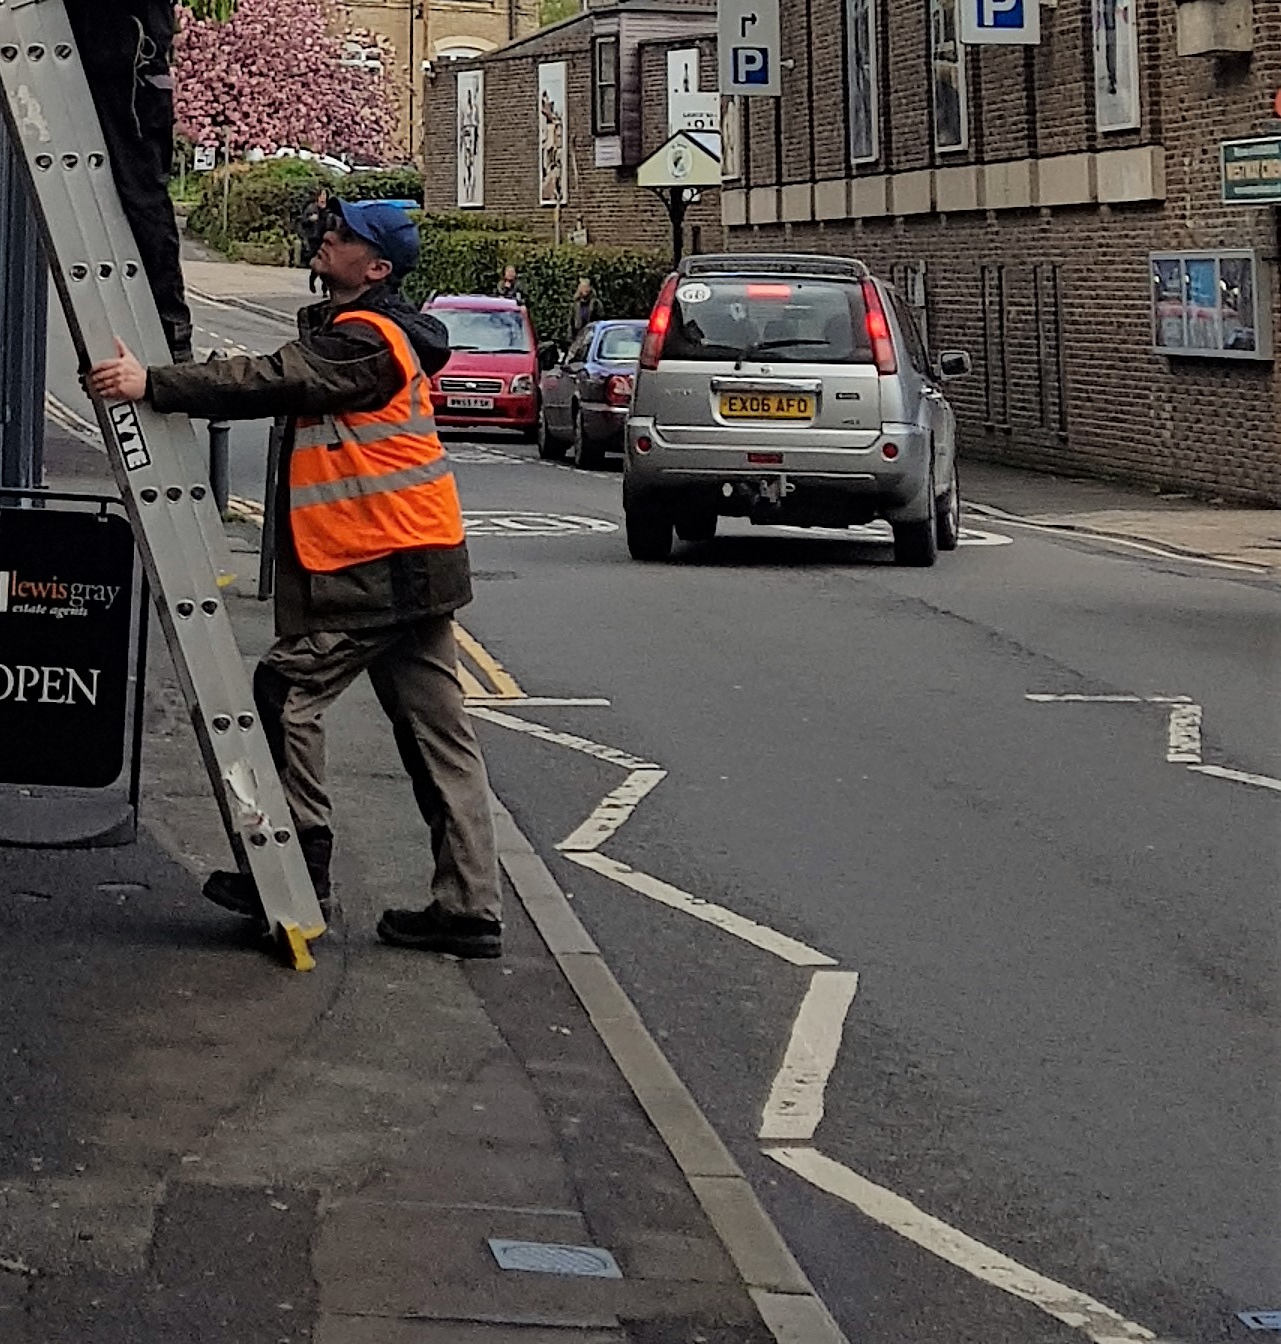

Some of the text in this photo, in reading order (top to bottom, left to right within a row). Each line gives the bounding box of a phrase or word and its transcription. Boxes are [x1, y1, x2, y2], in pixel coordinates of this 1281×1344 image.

[737, 49, 764, 83] P
[728, 396, 772, 413] EX06
[111, 402, 149, 470] LYTE
